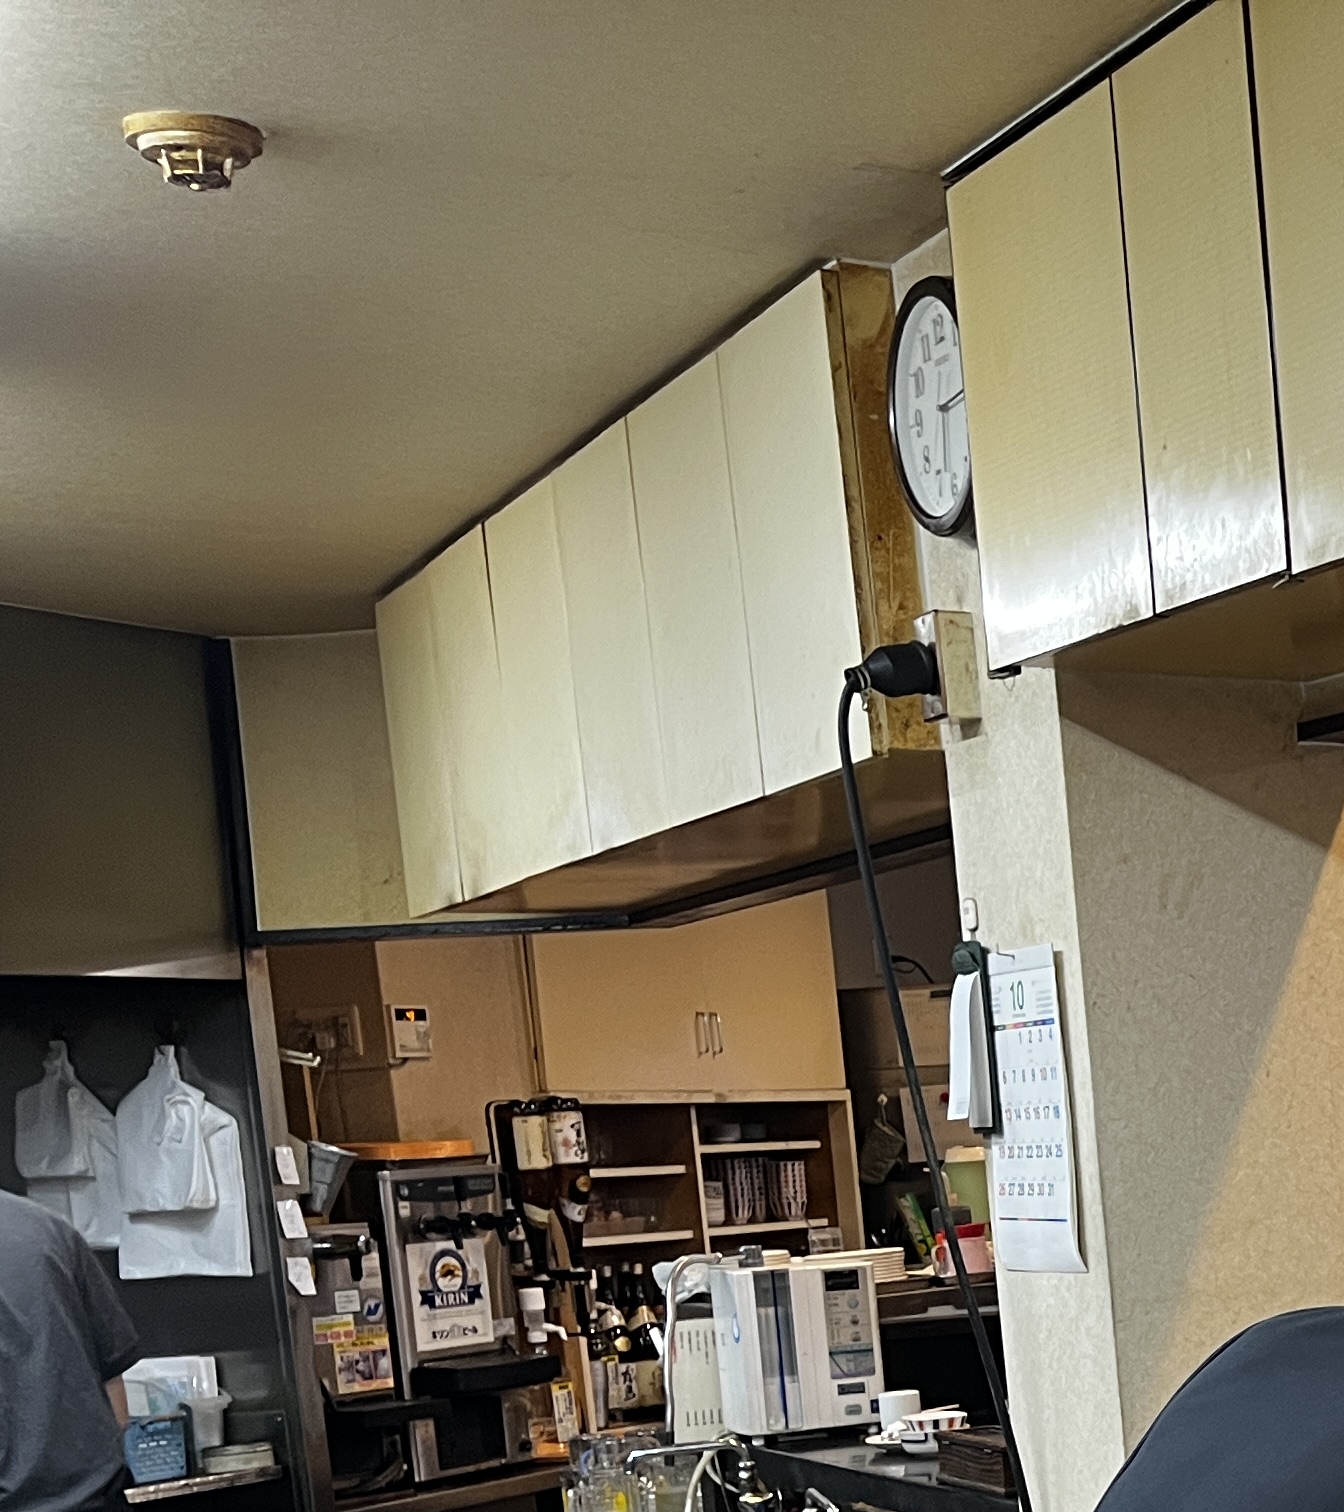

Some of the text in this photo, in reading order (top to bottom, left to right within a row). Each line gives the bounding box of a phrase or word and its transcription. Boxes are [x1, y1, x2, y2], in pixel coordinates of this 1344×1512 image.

[932, 313, 945, 346] 12
[914, 409, 924, 438] 9
[922, 445, 932, 475] 8
[1010, 980, 1025, 1011] 10
[1018, 1027, 1053, 1044] 1 2 3 4
[1002, 1067, 1058, 1084] 6 7 8 9 10 11
[1014, 1108, 1021, 1120] 14
[1043, 1106, 1050, 1119] 17
[1008, 1145, 1014, 1159] 20
[1017, 1145, 1023, 1159] 21
[1026, 1145, 1033, 1158] 22
[1036, 1145, 1043, 1158] 23
[1045, 1144, 1052, 1158] 24
[1055, 1144, 1063, 1158] 25
[999, 1183, 1054, 1196] 26 27 28 29 30 31
[435, 1291, 468, 1306] KIRIN
